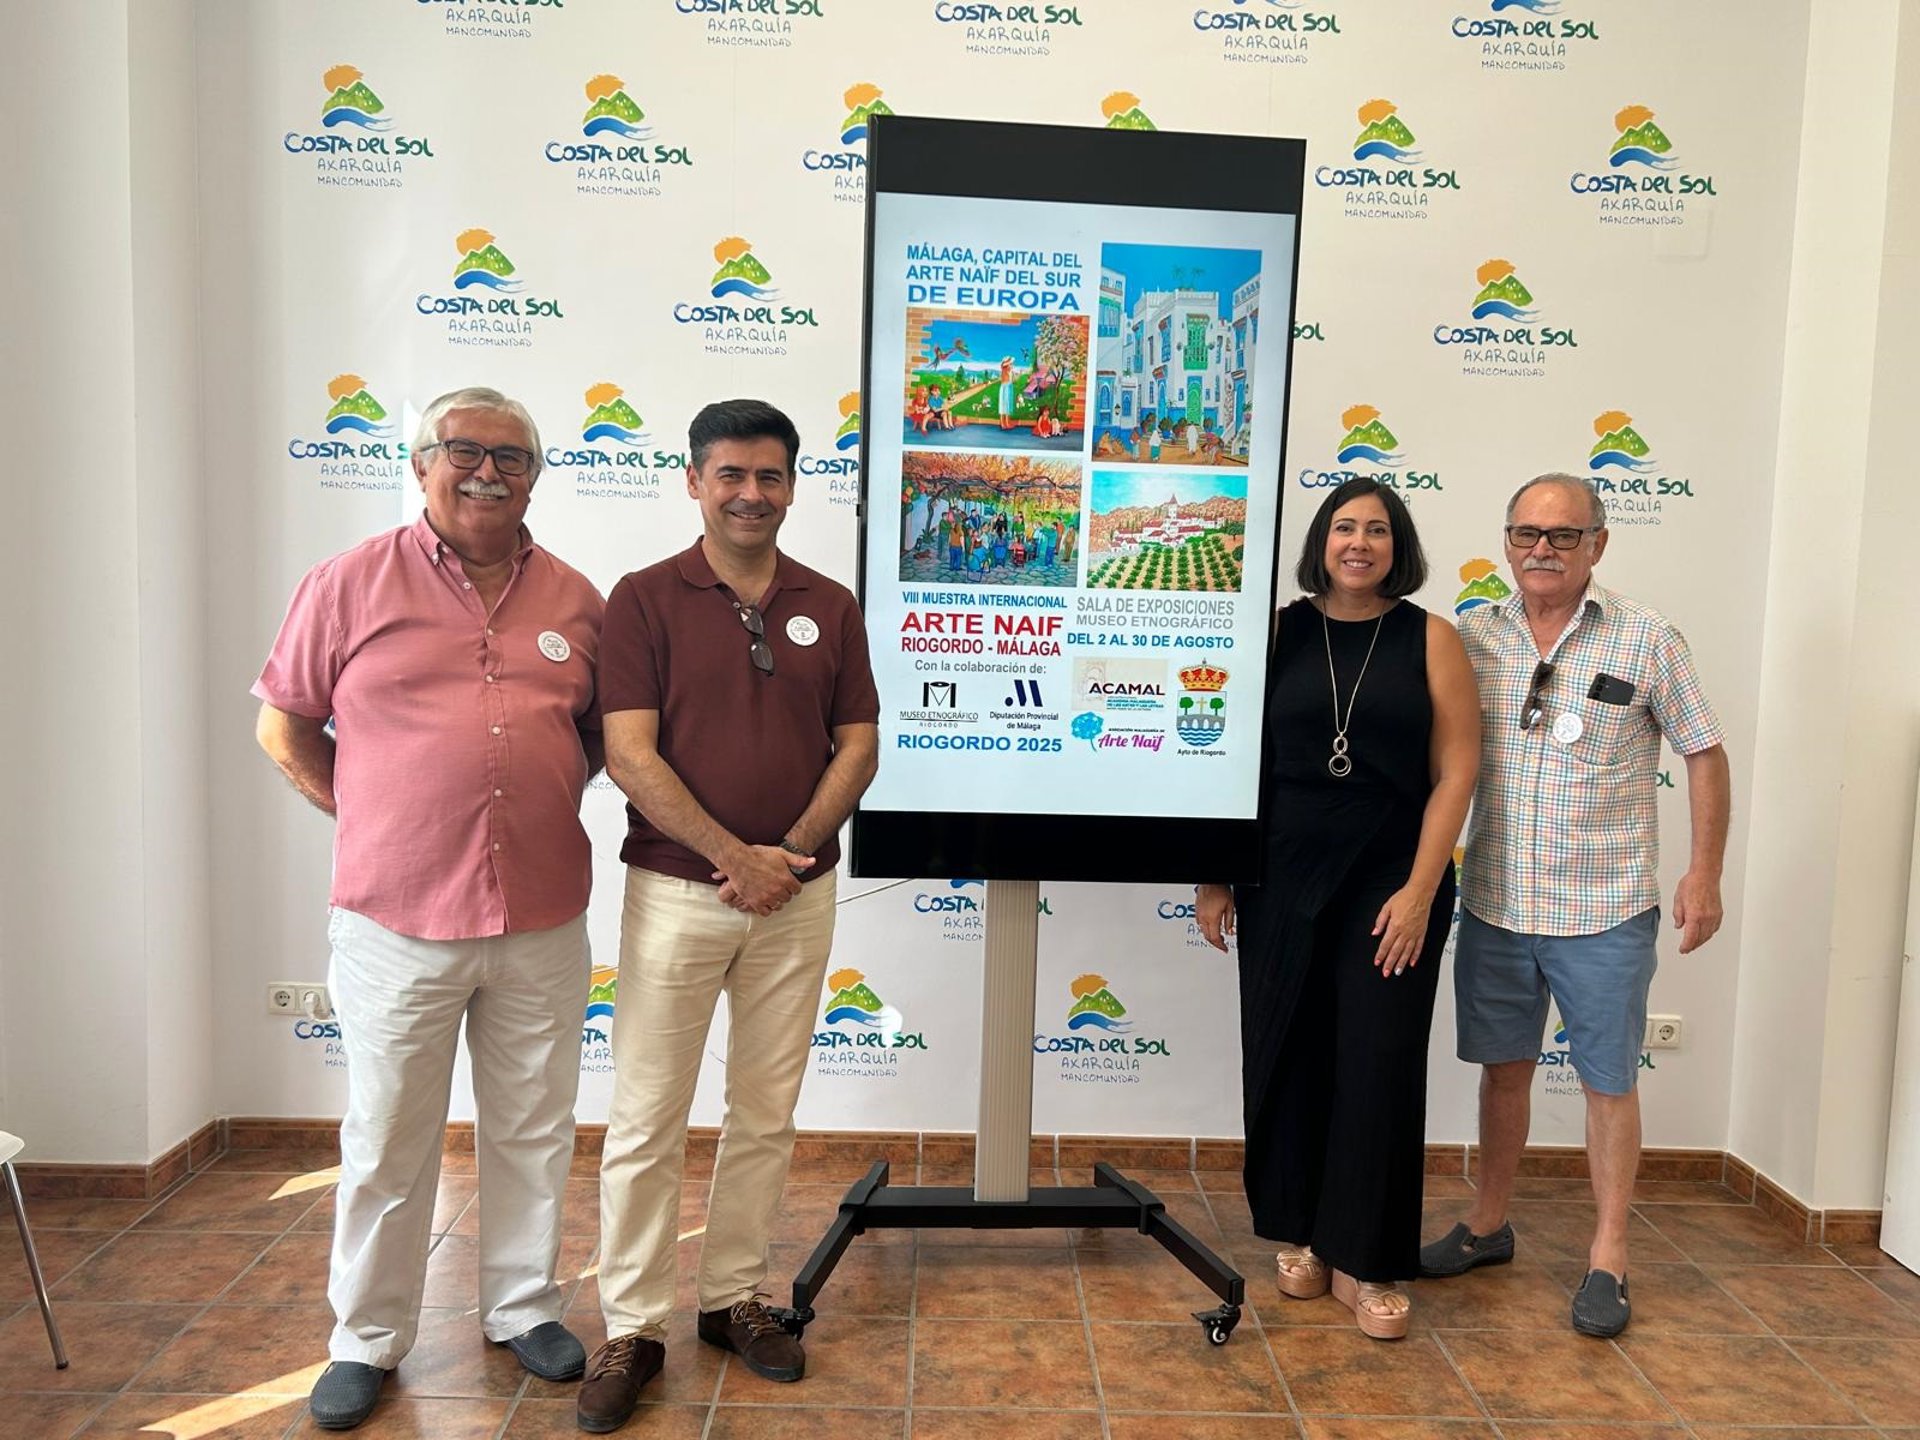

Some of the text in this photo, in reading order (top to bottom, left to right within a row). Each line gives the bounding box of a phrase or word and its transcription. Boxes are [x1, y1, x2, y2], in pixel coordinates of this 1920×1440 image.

[446, 8, 531, 24] AXARQUÍA
[935, 3, 1082, 25] COSTA DEL SOL
[1194, 11, 1340, 33] COSTA DEL SOL
[446, 26, 532, 38] MANCOMUNIDAD
[707, 17, 792, 34] AXARQUÍA
[966, 25, 1050, 43] AXARQUÍA
[1452, 18, 1599, 40] COSTA DEL SOL
[707, 36, 792, 48] MANCOMUNIDAD
[965, 44, 1051, 56] MANCOMUNIDAD
[1224, 33, 1308, 51] AXARQUÍA
[1482, 39, 1566, 57] AXARQUÍA
[1223, 53, 1308, 64] MANCOMUNIDAD
[1481, 59, 1566, 71] MANCOMUNIDAD
[284, 133, 433, 157] COSTA DEL SOL
[545, 143, 692, 166] COSTA DEL SOL
[317, 156, 402, 174] AXARQUÍA
[317, 175, 403, 188] MANCOMUNIDAD
[577, 165, 661, 183] AXARQUÍA
[1315, 167, 1460, 189] COSTA DEL SOL
[576, 185, 662, 196] MANCOMUNIDAD
[1571, 173, 1716, 195] COSTA DEL SOL
[1345, 189, 1428, 206] AXARQUÍA
[1600, 196, 1684, 212] AXARQUÍA
[1344, 208, 1428, 220] MANCOMUNIDAD
[1599, 215, 1684, 226] MANCOMUNIDAD
[907, 242, 1082, 268] MÁLAGA, CAPITAL DEL
[906, 264, 1081, 288] ARTE NAÏF DEL SUR
[416, 295, 563, 318] COSTA DEL SOL
[907, 285, 1080, 311] DE EUROPA
[674, 304, 818, 326] COSTA DEL SOL
[448, 317, 532, 334] AXARQUÍA
[705, 325, 787, 343] AXARQUÍA
[448, 336, 532, 348] MANCOMUNIDAD
[1434, 326, 1577, 347] COSTA DEL SOL
[704, 345, 787, 356] MANCOMUNIDAD
[1463, 347, 1546, 364] AXARQUÍA
[1462, 366, 1545, 377] MANCOMUNIDAD
[288, 438, 355, 459] COSTA
[360, 443, 391, 459] DEL
[544, 448, 612, 468] COSTA
[616, 452, 648, 468] DEL
[576, 470, 660, 487] AXARQUÍA
[1300, 469, 1360, 488] COST
[1406, 471, 1443, 490] SOL
[576, 488, 660, 499] MANCOMUNIDAD
[1620, 479, 1651, 495] DEL
[1657, 478, 1694, 497] SOL
[1603, 498, 1662, 513] ARQUÍA
[902, 591, 1068, 608] VIII MUESTRA INTERNACIONAL
[1077, 596, 1234, 616] SALA DE EXPOSICIONES
[900, 611, 1064, 636] ARTE NAIF
[1076, 614, 1234, 630] MUSEO ETNOGRÁFICO
[901, 637, 984, 654] RIOGORDO
[997, 637, 1062, 656] MÁLAGA
[1067, 632, 1234, 649] DEL 2 AL 30 DE AGOSTO
[915, 659, 1047, 674] Con la colaboración de:
[1089, 682, 1166, 696] ACAMAL
[900, 710, 979, 720] MUSEO ETNOGRÁFICO
[989, 711, 1059, 721] Diputación Provincial
[1016, 722, 1041, 731] Málaga
[898, 734, 1063, 752] RIOGORDO 2025
[1098, 733, 1164, 752] Arte Naïf
[914, 893, 977, 913] COSTA
[1157, 900, 1196, 919] COS
[943, 916, 984, 930] AXAR
[857, 1033, 886, 1048] DEL
[1034, 1036, 1170, 1056] COSTA DEL SOL
[818, 1050, 898, 1065] AXARQUÍA
[1061, 1055, 1140, 1072] AXARQUÍA
[817, 1067, 897, 1077] MANCOMUNIDAD
[1060, 1073, 1140, 1084] MANCOMUNIDAD
